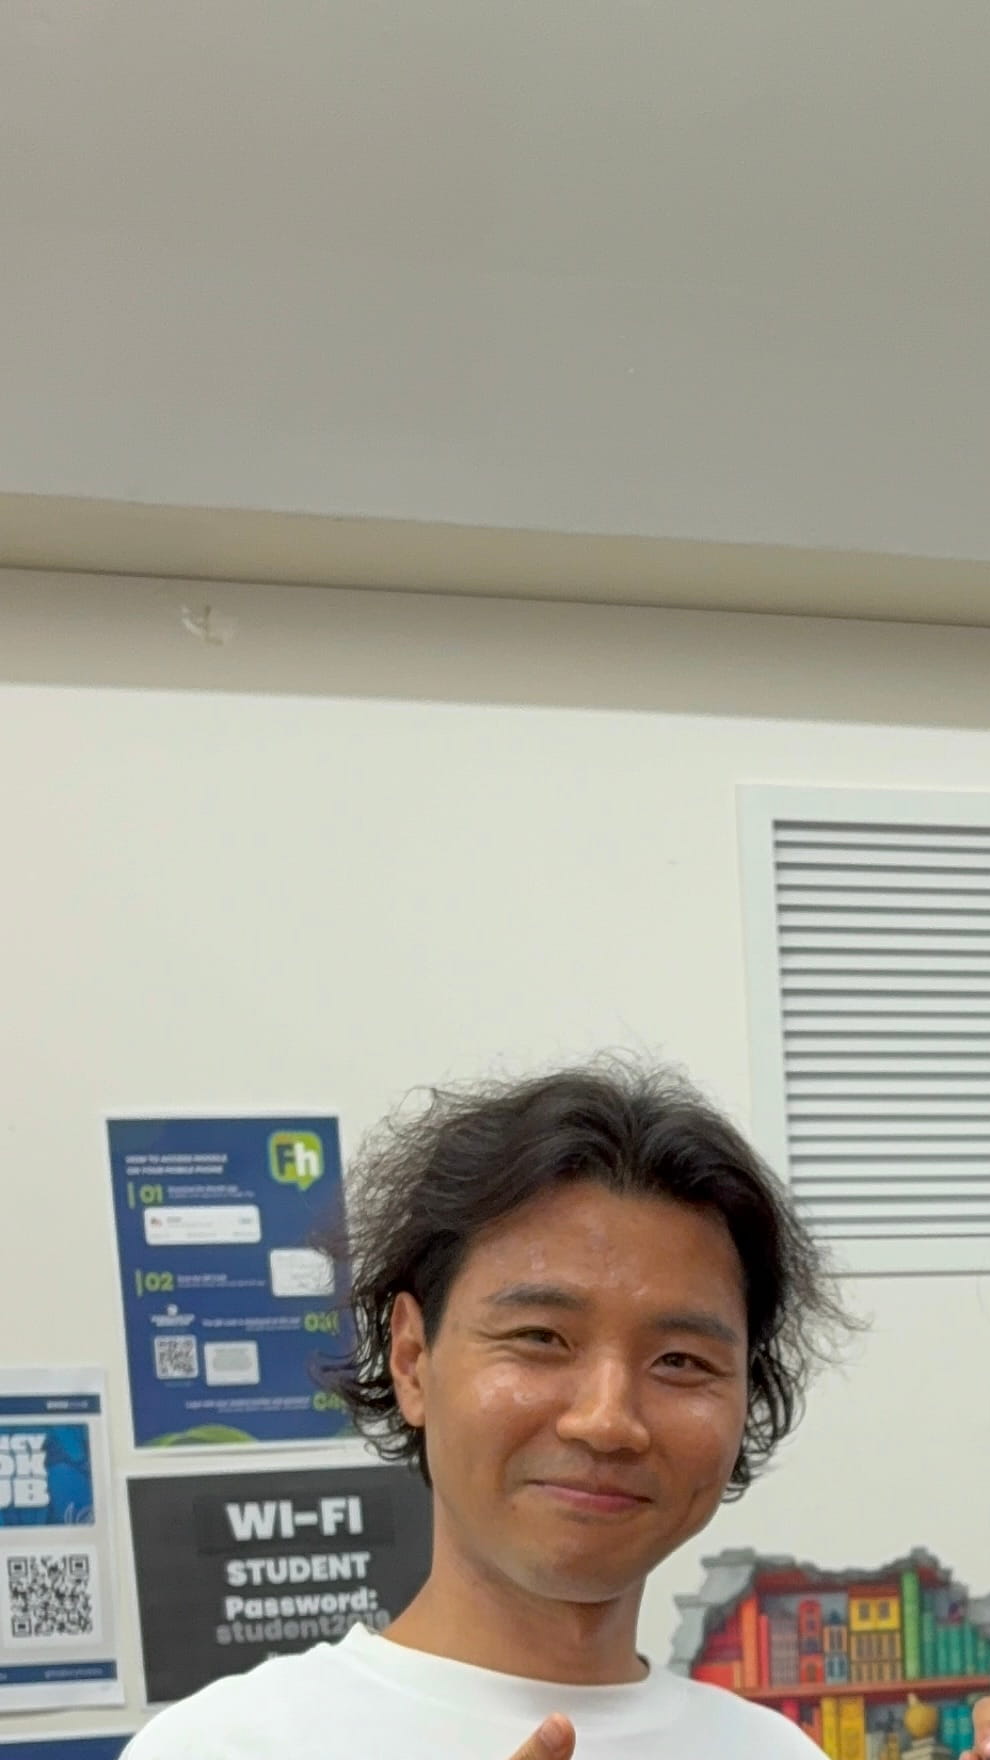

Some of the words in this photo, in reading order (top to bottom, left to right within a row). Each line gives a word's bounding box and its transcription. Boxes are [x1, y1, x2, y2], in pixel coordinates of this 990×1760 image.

[276, 1141, 318, 1177] Fh
[139, 1185, 163, 1204] 01
[145, 1271, 174, 1292] 02
[225, 1495, 364, 1541] WI-FI
[226, 1551, 371, 1587] STUDENT
[224, 1586, 378, 1621] Password:
